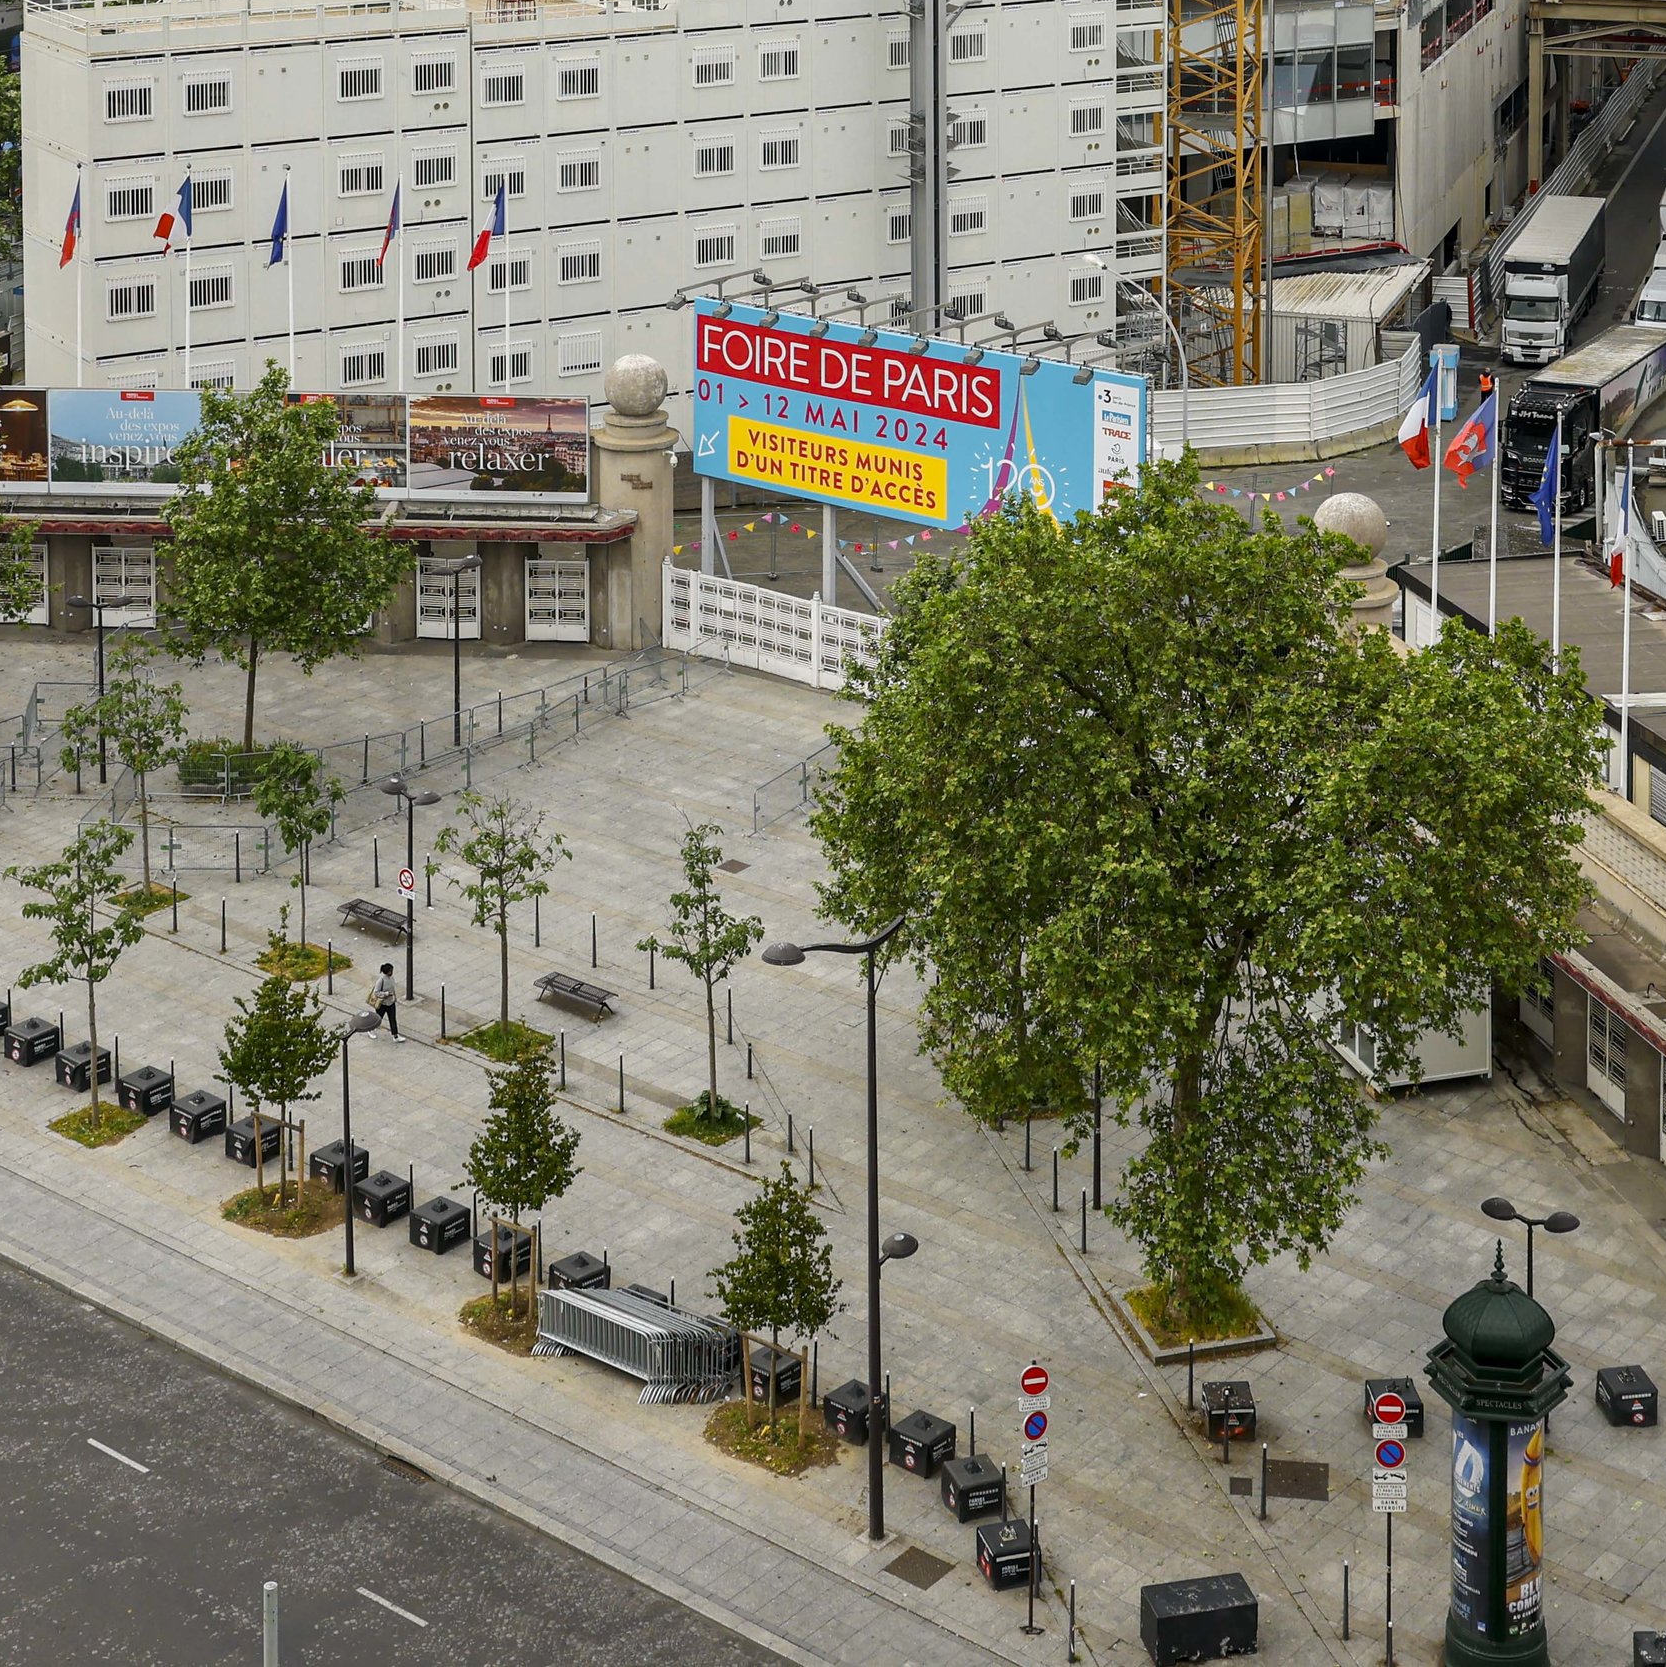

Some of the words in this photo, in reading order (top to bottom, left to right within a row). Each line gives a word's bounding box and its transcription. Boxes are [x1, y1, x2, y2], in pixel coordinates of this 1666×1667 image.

[703, 324, 810, 385] FOIRE
[820, 348, 872, 397] DE
[883, 358, 993, 419] PARIS
[1103, 389, 1111, 403] 3
[105, 407, 153, 419] Au-delà
[460, 413, 506, 425] Au-delà
[698, 378, 724, 405] 01
[763, 393, 789, 419] 12
[804, 401, 859, 434] MAI
[876, 415, 949, 451] 2024
[120, 420, 141, 431] des
[144, 422, 179, 433] expos
[336, 424, 362, 436] xpos
[474, 426, 495, 436] des
[497, 427, 531, 439] expos
[108, 432, 142, 441] venez
[149, 432, 177, 442] vous
[442, 437, 477, 446] venez
[480, 437, 510, 446] vous
[80, 437, 181, 471] inspire
[449, 438, 550, 471] relaxer
[748, 428, 848, 466] VISITEURS
[856, 452, 923, 482] MUNIS
[1107, 456, 1125, 464] PARIS
[736, 450, 783, 477] D'UN
[789, 462, 843, 490] TITRE
[850, 474, 936, 510] D'ACCÈS
[980, 457, 1056, 510] 120
[1029, 478, 1044, 486] ANS
[1476, 1399, 1522, 1410] SPECTACLES
